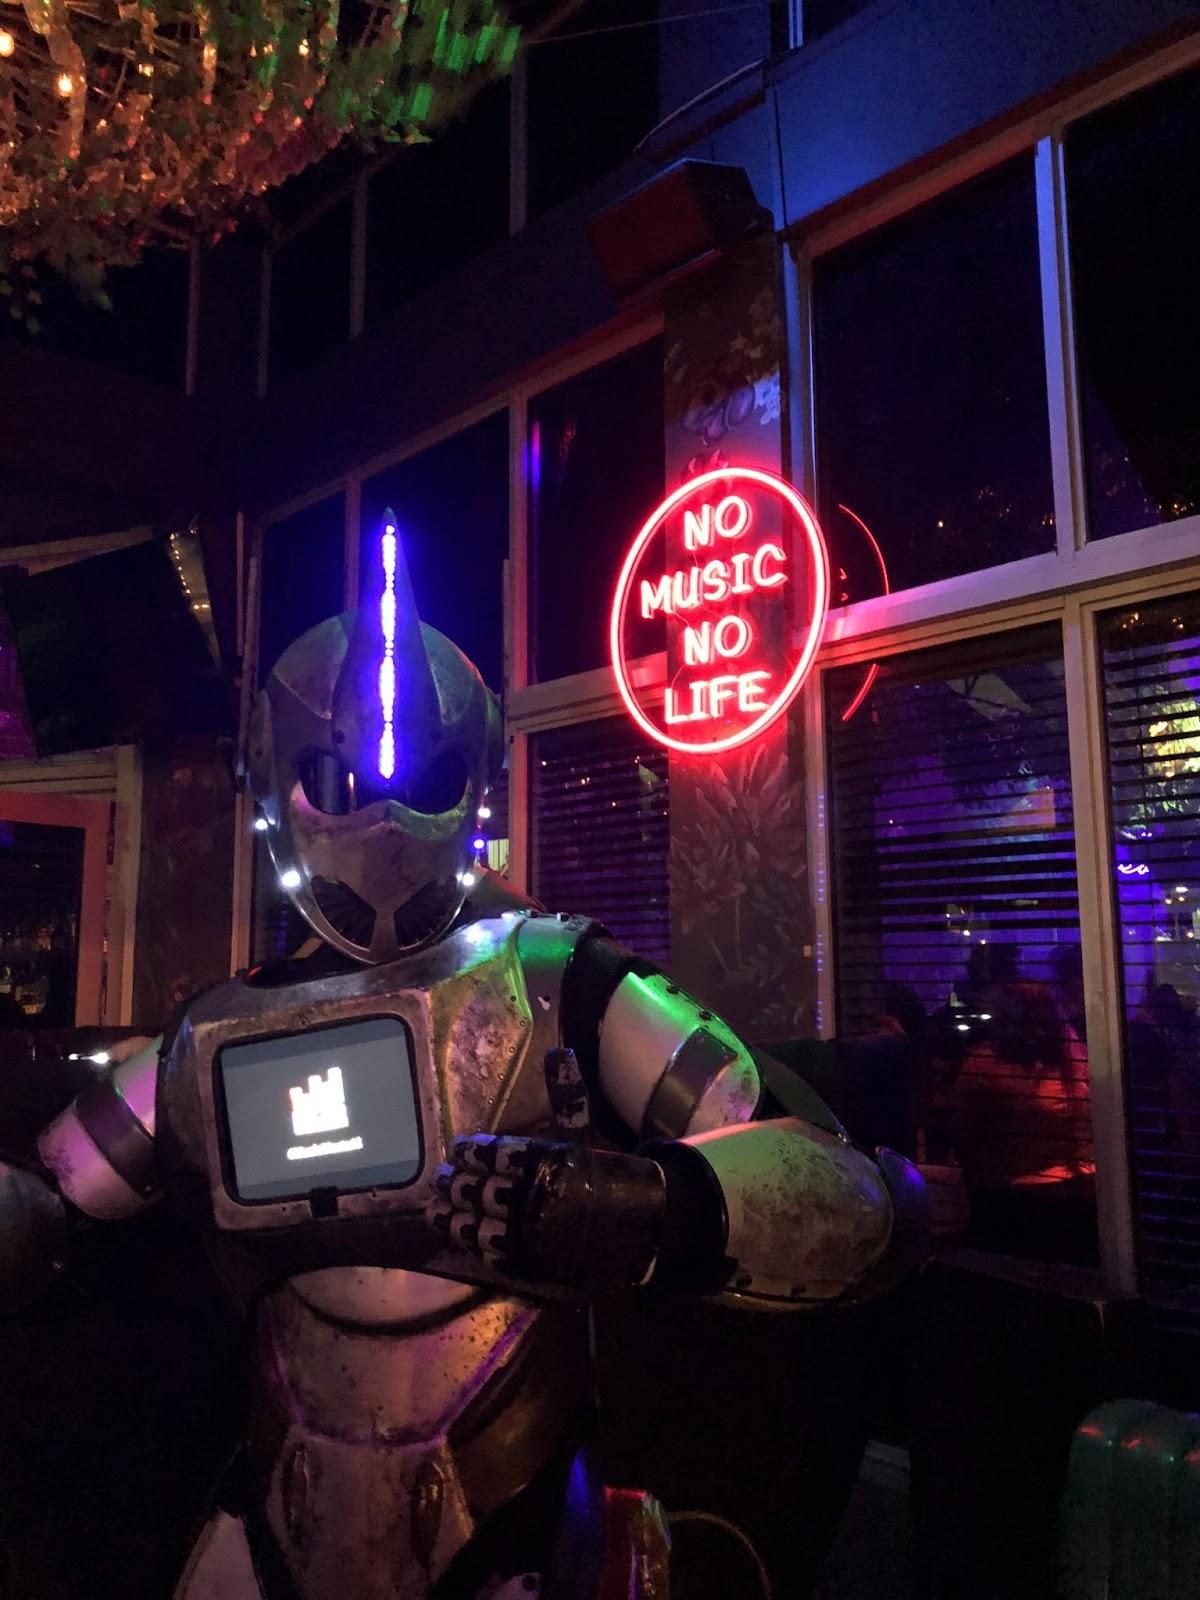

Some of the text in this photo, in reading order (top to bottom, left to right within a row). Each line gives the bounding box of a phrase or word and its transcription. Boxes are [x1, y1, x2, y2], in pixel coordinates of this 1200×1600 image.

[684, 495, 748, 551] NO
[640, 543, 787, 619] MUSIC
[685, 615, 748, 666] NO
[665, 670, 771, 725] LIFE
